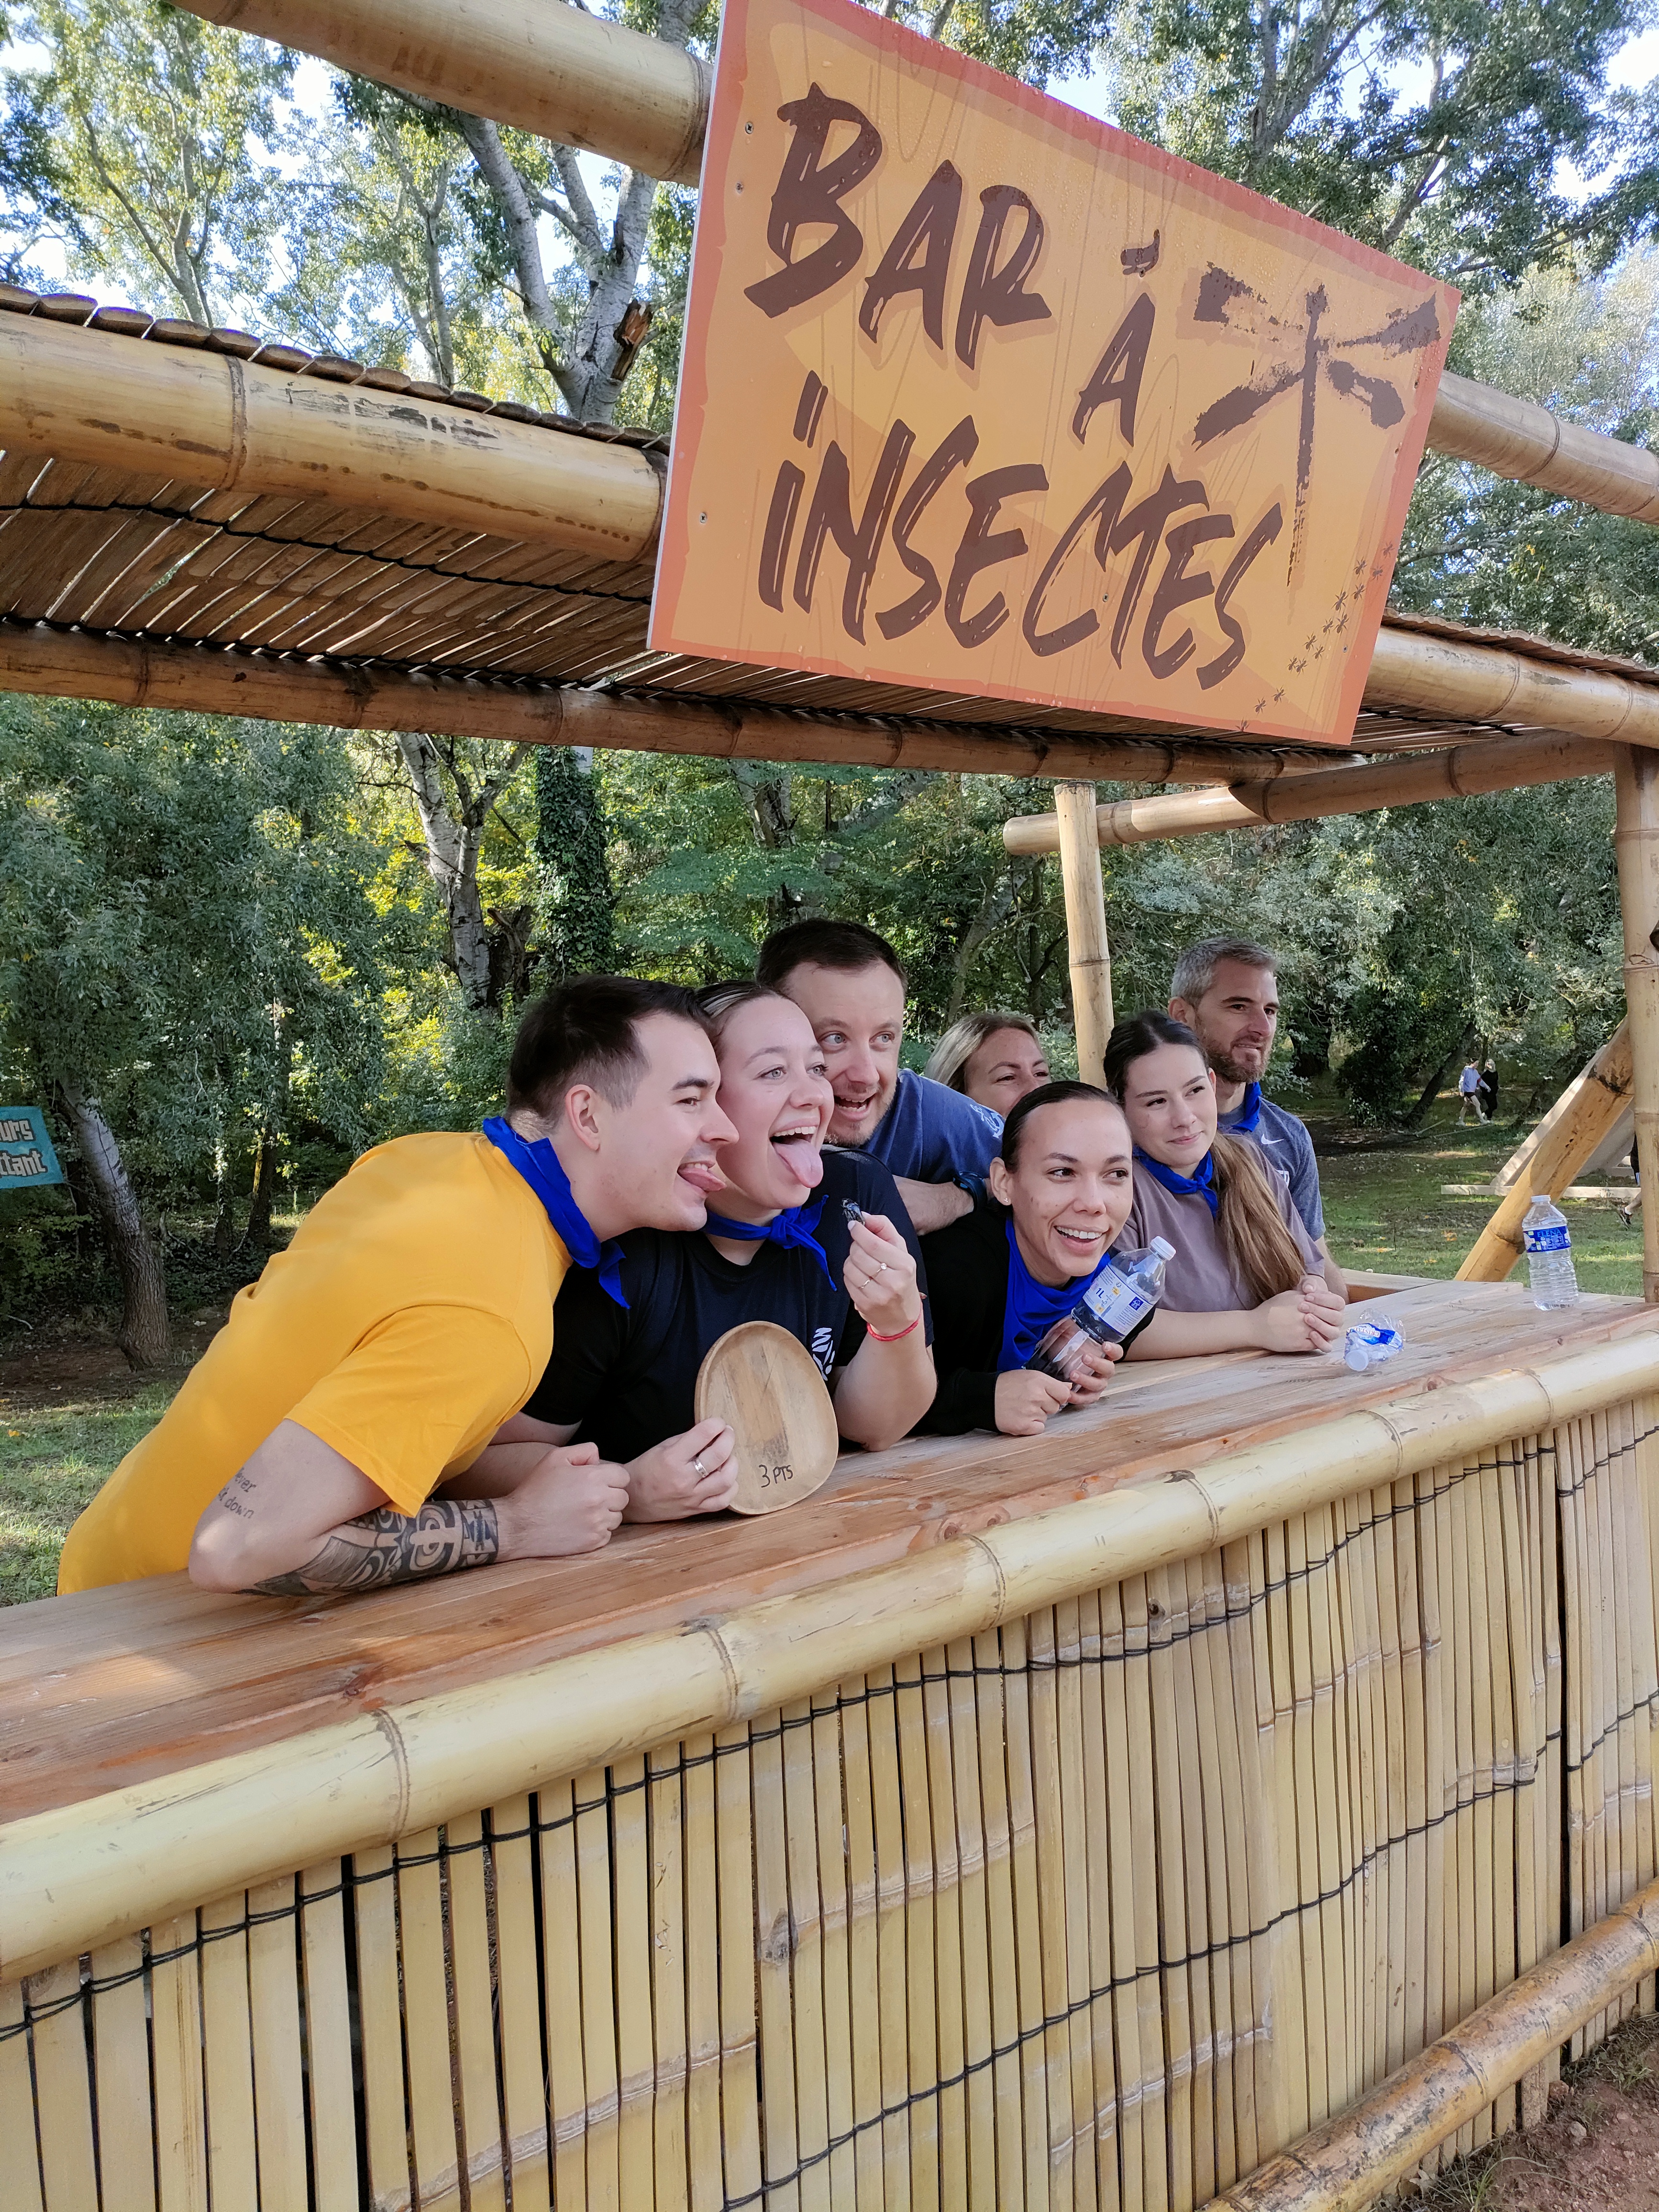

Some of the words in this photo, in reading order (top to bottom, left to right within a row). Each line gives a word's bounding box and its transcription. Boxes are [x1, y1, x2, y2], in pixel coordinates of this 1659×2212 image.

[744, 82, 1051, 370] BAR
[1073, 229, 1161, 447] À
[0, 1120, 33, 1141] urs
[1095, 1287, 1105, 1299] 1L
[759, 1464, 771, 1488] 3
